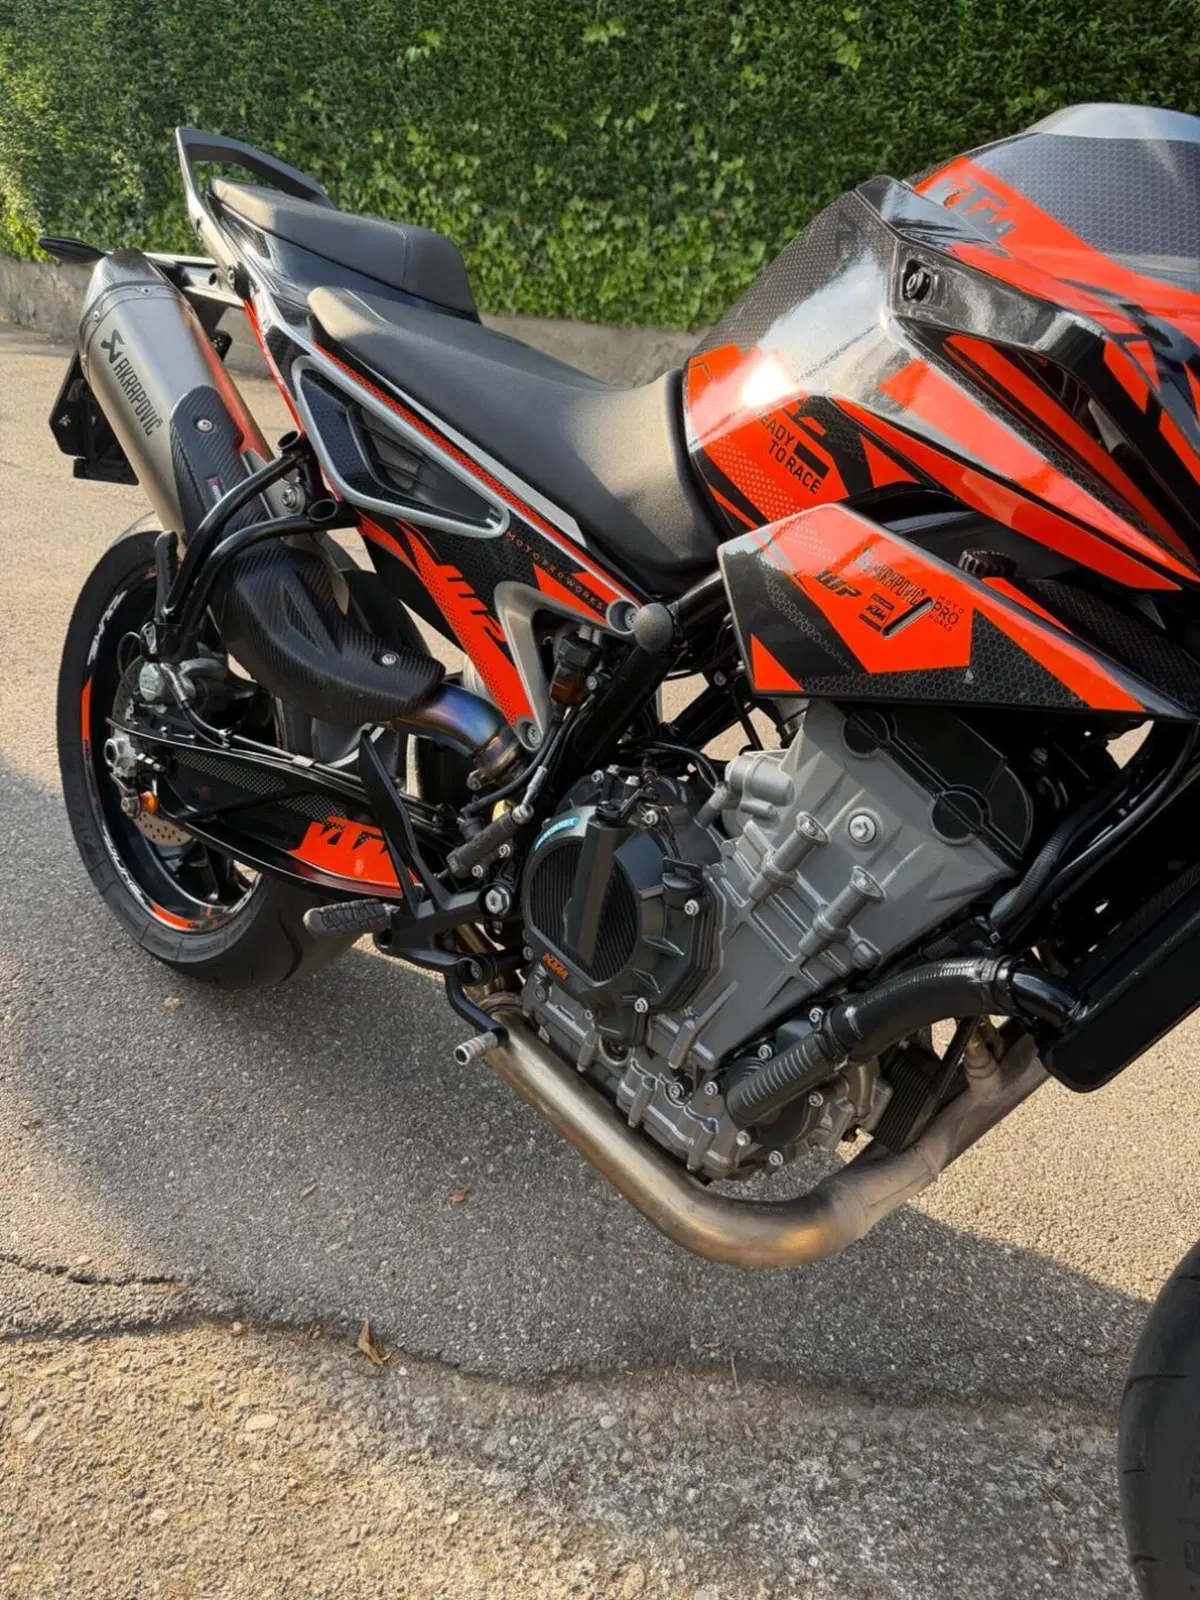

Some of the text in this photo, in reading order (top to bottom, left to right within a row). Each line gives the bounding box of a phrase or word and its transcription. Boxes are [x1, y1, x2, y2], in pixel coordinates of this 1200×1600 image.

[757, 413, 795, 447] EADY
[768, 438, 822, 495] TO RACE
[814, 569, 862, 598] WP
[866, 605, 887, 621] KTM
[932, 601, 960, 625] PRO
[938, 595, 964, 613] MOTO
[928, 614, 953, 632] WORKS
[542, 953, 568, 980] KTM
